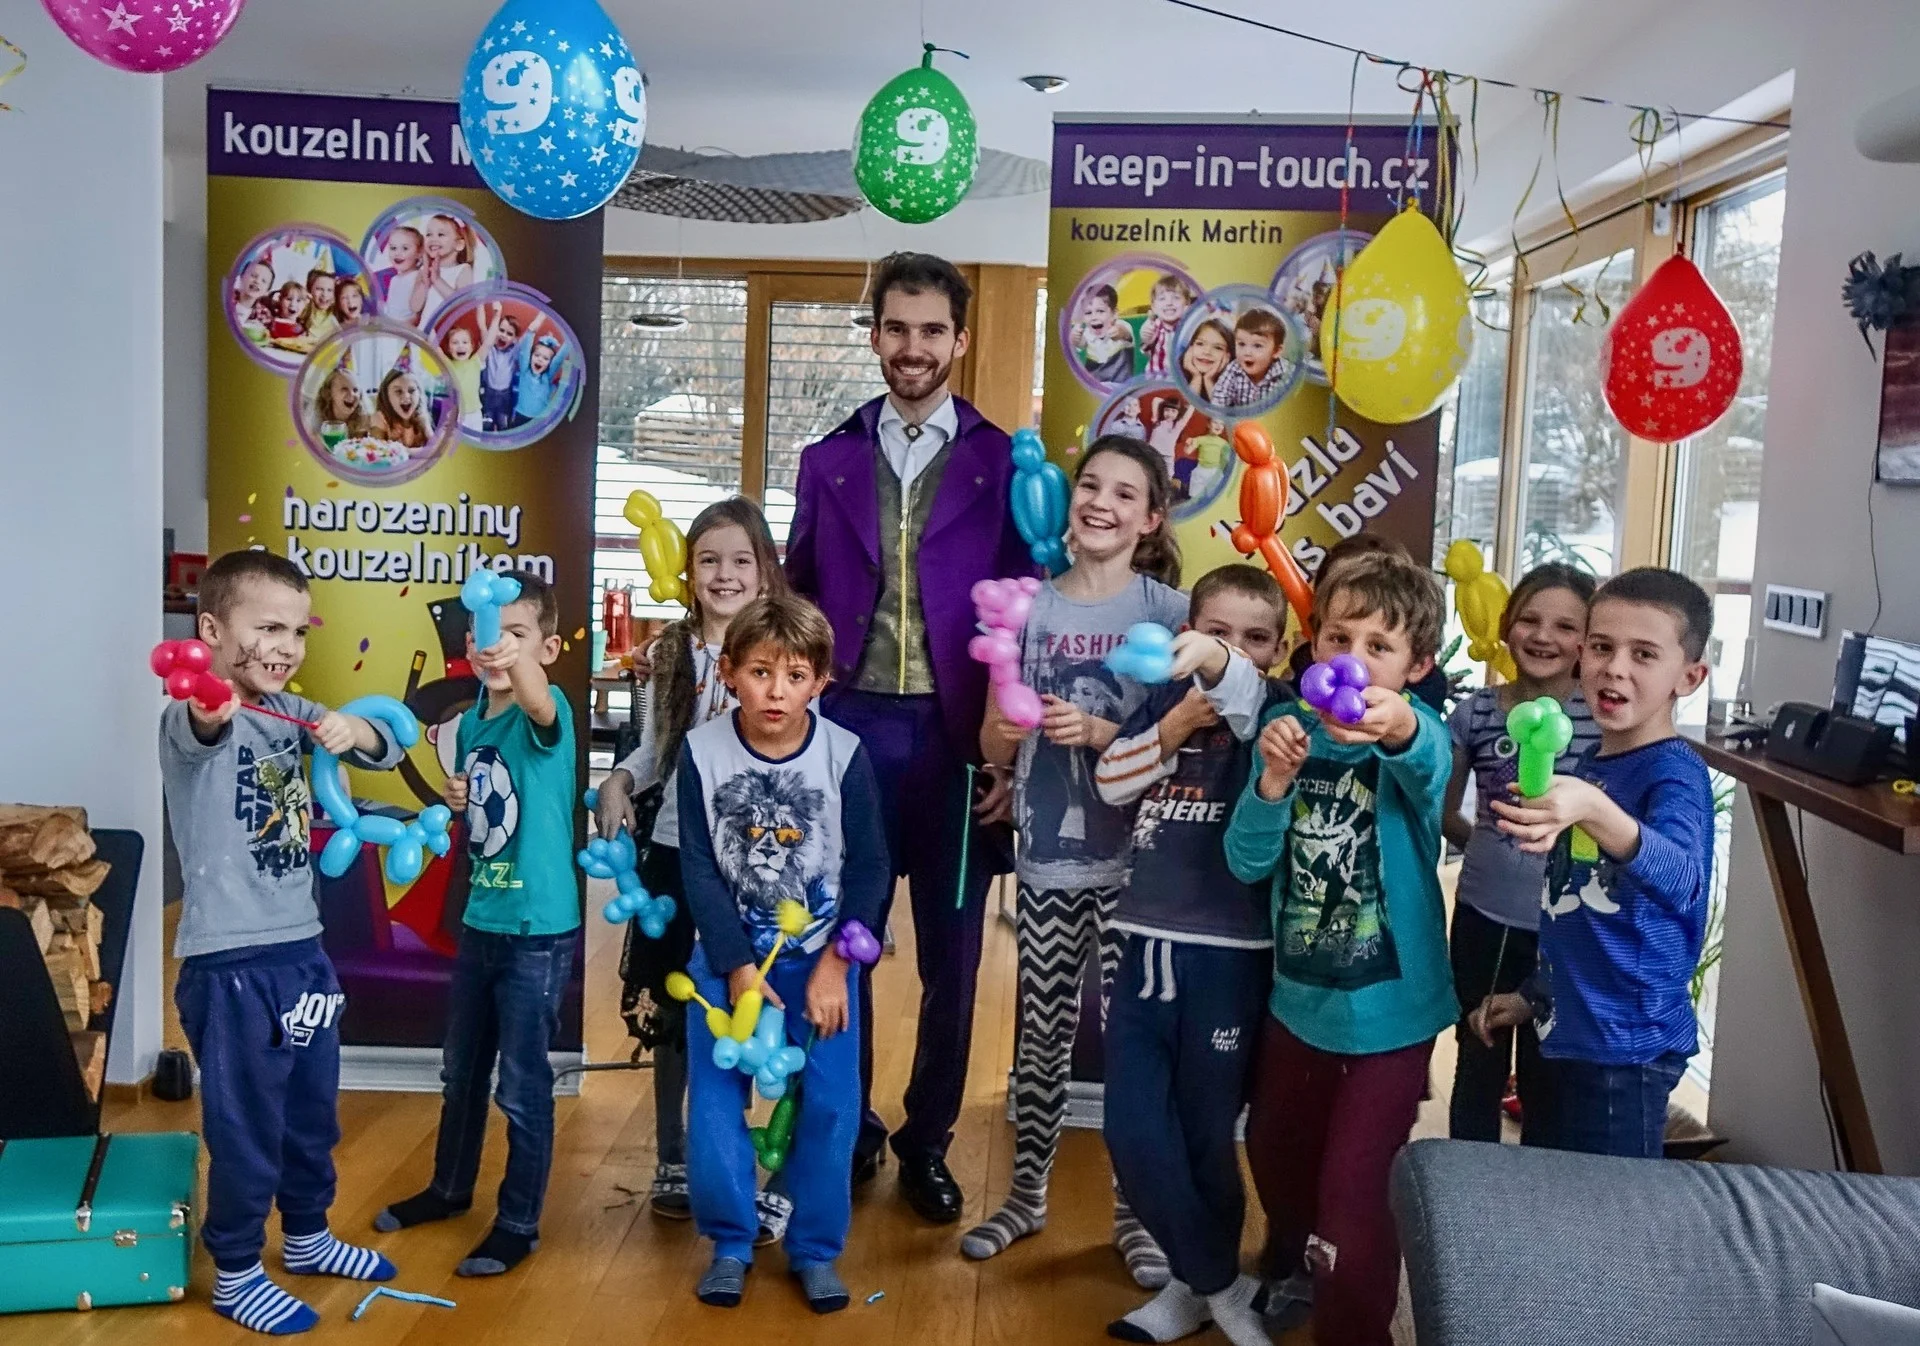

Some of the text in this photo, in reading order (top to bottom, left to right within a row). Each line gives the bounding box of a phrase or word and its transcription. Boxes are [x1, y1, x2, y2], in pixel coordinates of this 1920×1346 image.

[483, 51, 552, 134] 9
[224, 111, 434, 164] kouzelník
[896, 107, 949, 165] 9
[1073, 143, 1430, 196] keep-in-touch.cz
[1071, 219, 1283, 244] kouzelník Martin
[1343, 298, 1407, 361] 9
[1651, 327, 1711, 388] 9
[1316, 439, 1419, 539] baví
[283, 493, 521, 546] narozeniny
[287, 536, 555, 586] kouzelníkem
